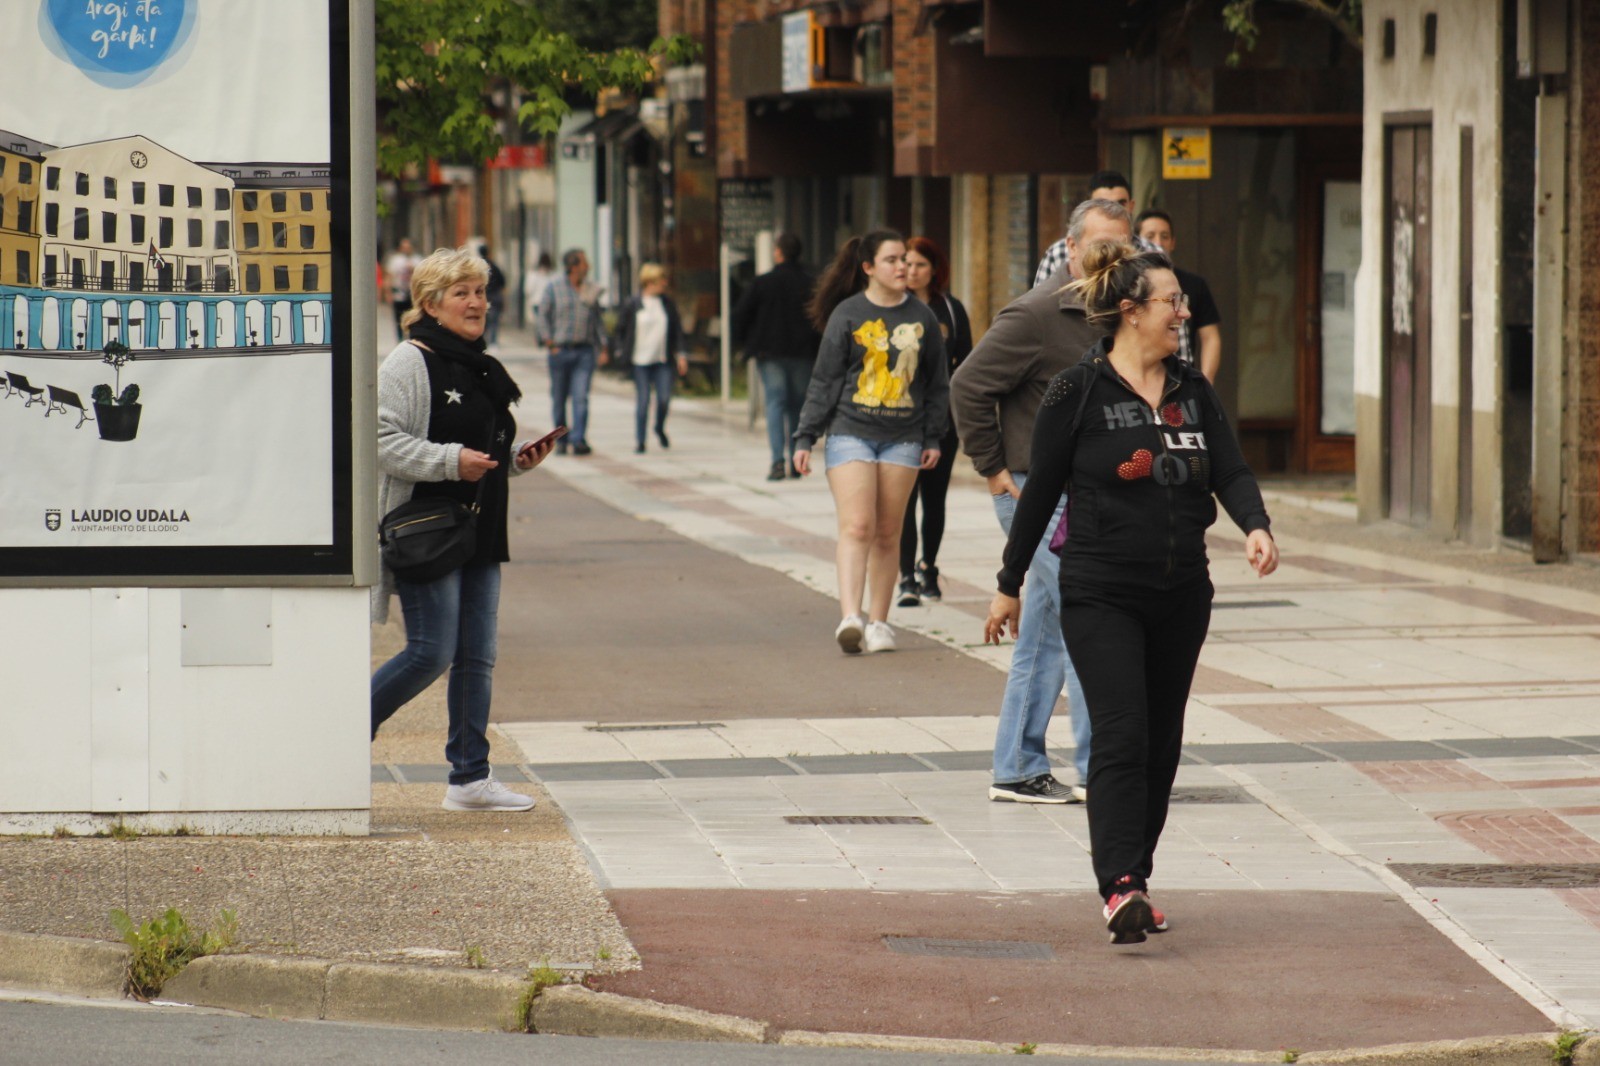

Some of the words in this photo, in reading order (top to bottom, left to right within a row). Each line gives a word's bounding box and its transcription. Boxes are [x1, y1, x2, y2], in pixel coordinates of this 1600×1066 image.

[85, 0, 128, 31] Argi
[135, 0, 162, 22] eta
[91, 25, 157, 59] garbi!
[71, 509, 132, 522] LAUDIO
[136, 509, 190, 522] UDALA
